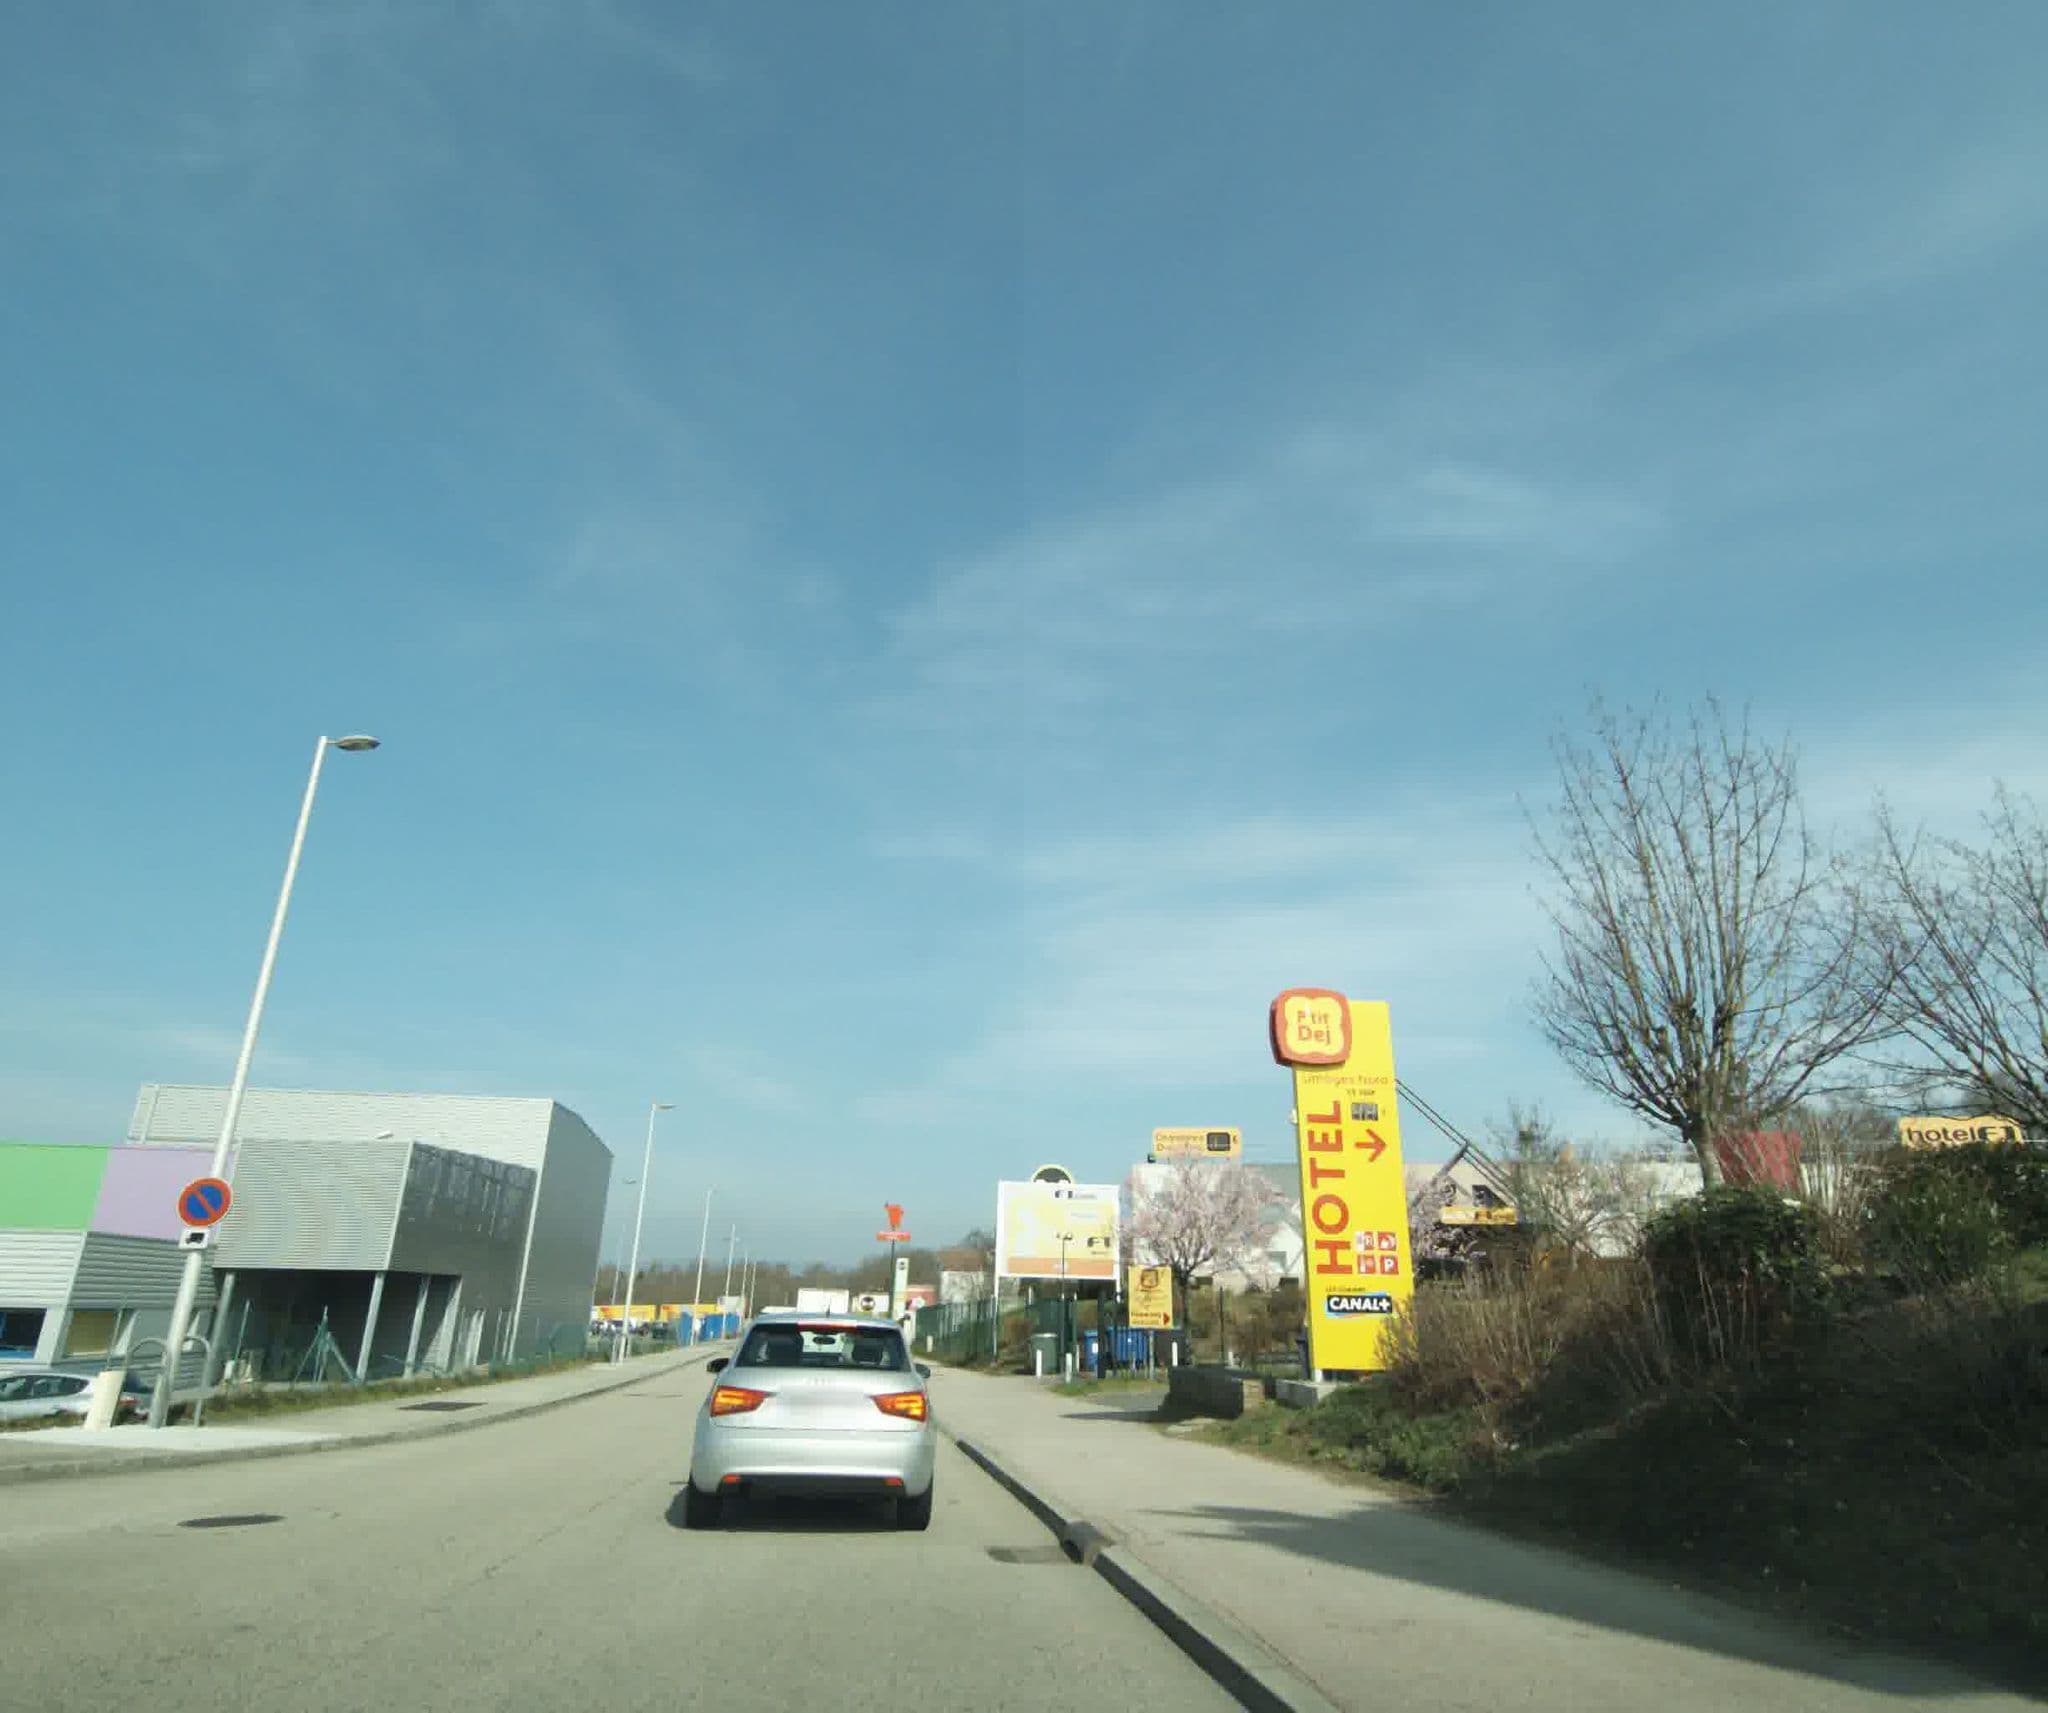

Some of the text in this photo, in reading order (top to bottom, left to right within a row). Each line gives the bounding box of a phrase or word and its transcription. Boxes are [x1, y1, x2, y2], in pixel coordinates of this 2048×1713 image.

[1297, 1009, 1330, 1025] Ptit
[1306, 1100, 1354, 1275] HOTEL
[1328, 1295, 1391, 1311] CANAL+
